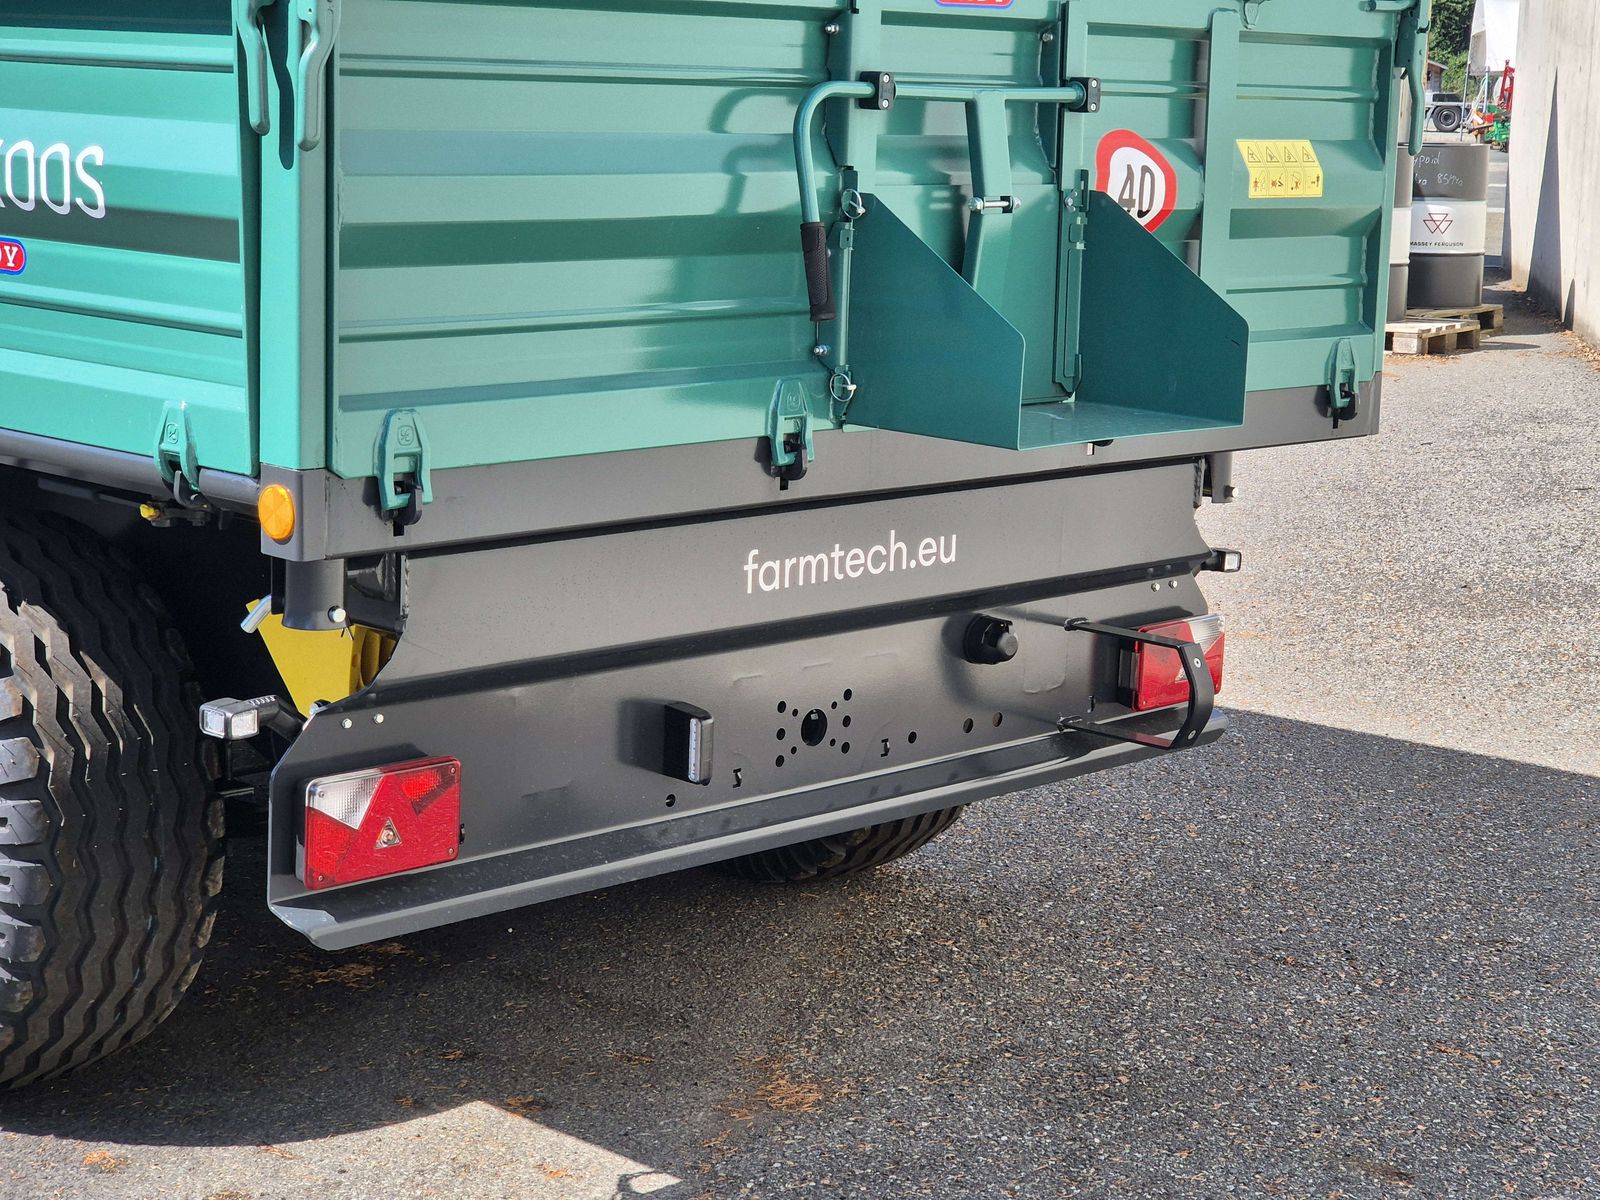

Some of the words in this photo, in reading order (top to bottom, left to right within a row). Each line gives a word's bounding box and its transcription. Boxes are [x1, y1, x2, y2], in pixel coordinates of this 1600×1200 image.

[0, 139, 106, 219] OOS
[1117, 163, 1155, 219] 40
[0, 244, 19, 268] Y
[743, 529, 957, 594] farmtech.eu
